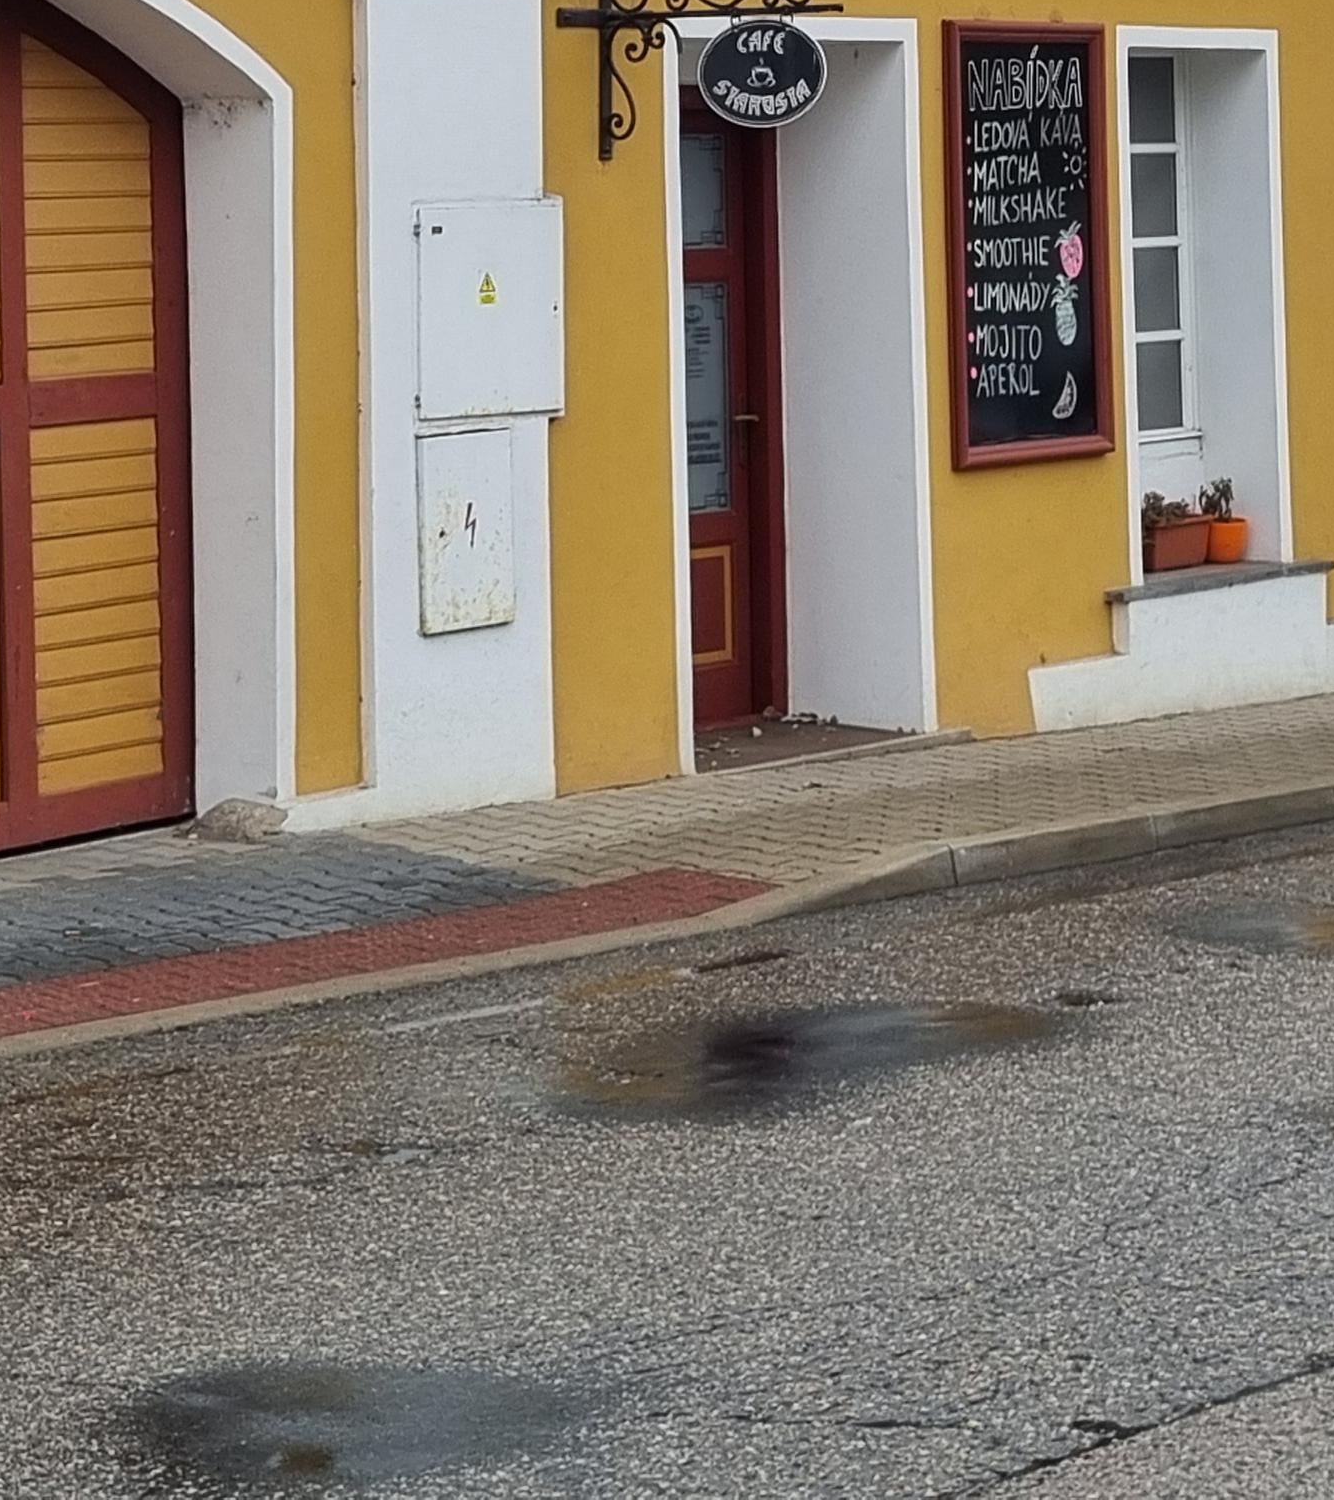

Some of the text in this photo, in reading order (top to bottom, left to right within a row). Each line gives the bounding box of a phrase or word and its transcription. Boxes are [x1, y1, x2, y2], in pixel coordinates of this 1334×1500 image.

[736, 30, 786, 55] CAFE
[712, 78, 812, 116] STAROSTA
[968, 45, 1083, 112] NABÍDKA
[973, 151, 1042, 192] MATCHA
[973, 187, 1067, 226] MILKSHAKE
[974, 236, 1051, 267] SMOOTHIE
[974, 271, 1051, 314] LIMONÁDY
[976, 325, 1043, 361] MOJITO
[976, 364, 1040, 397] APEROL
